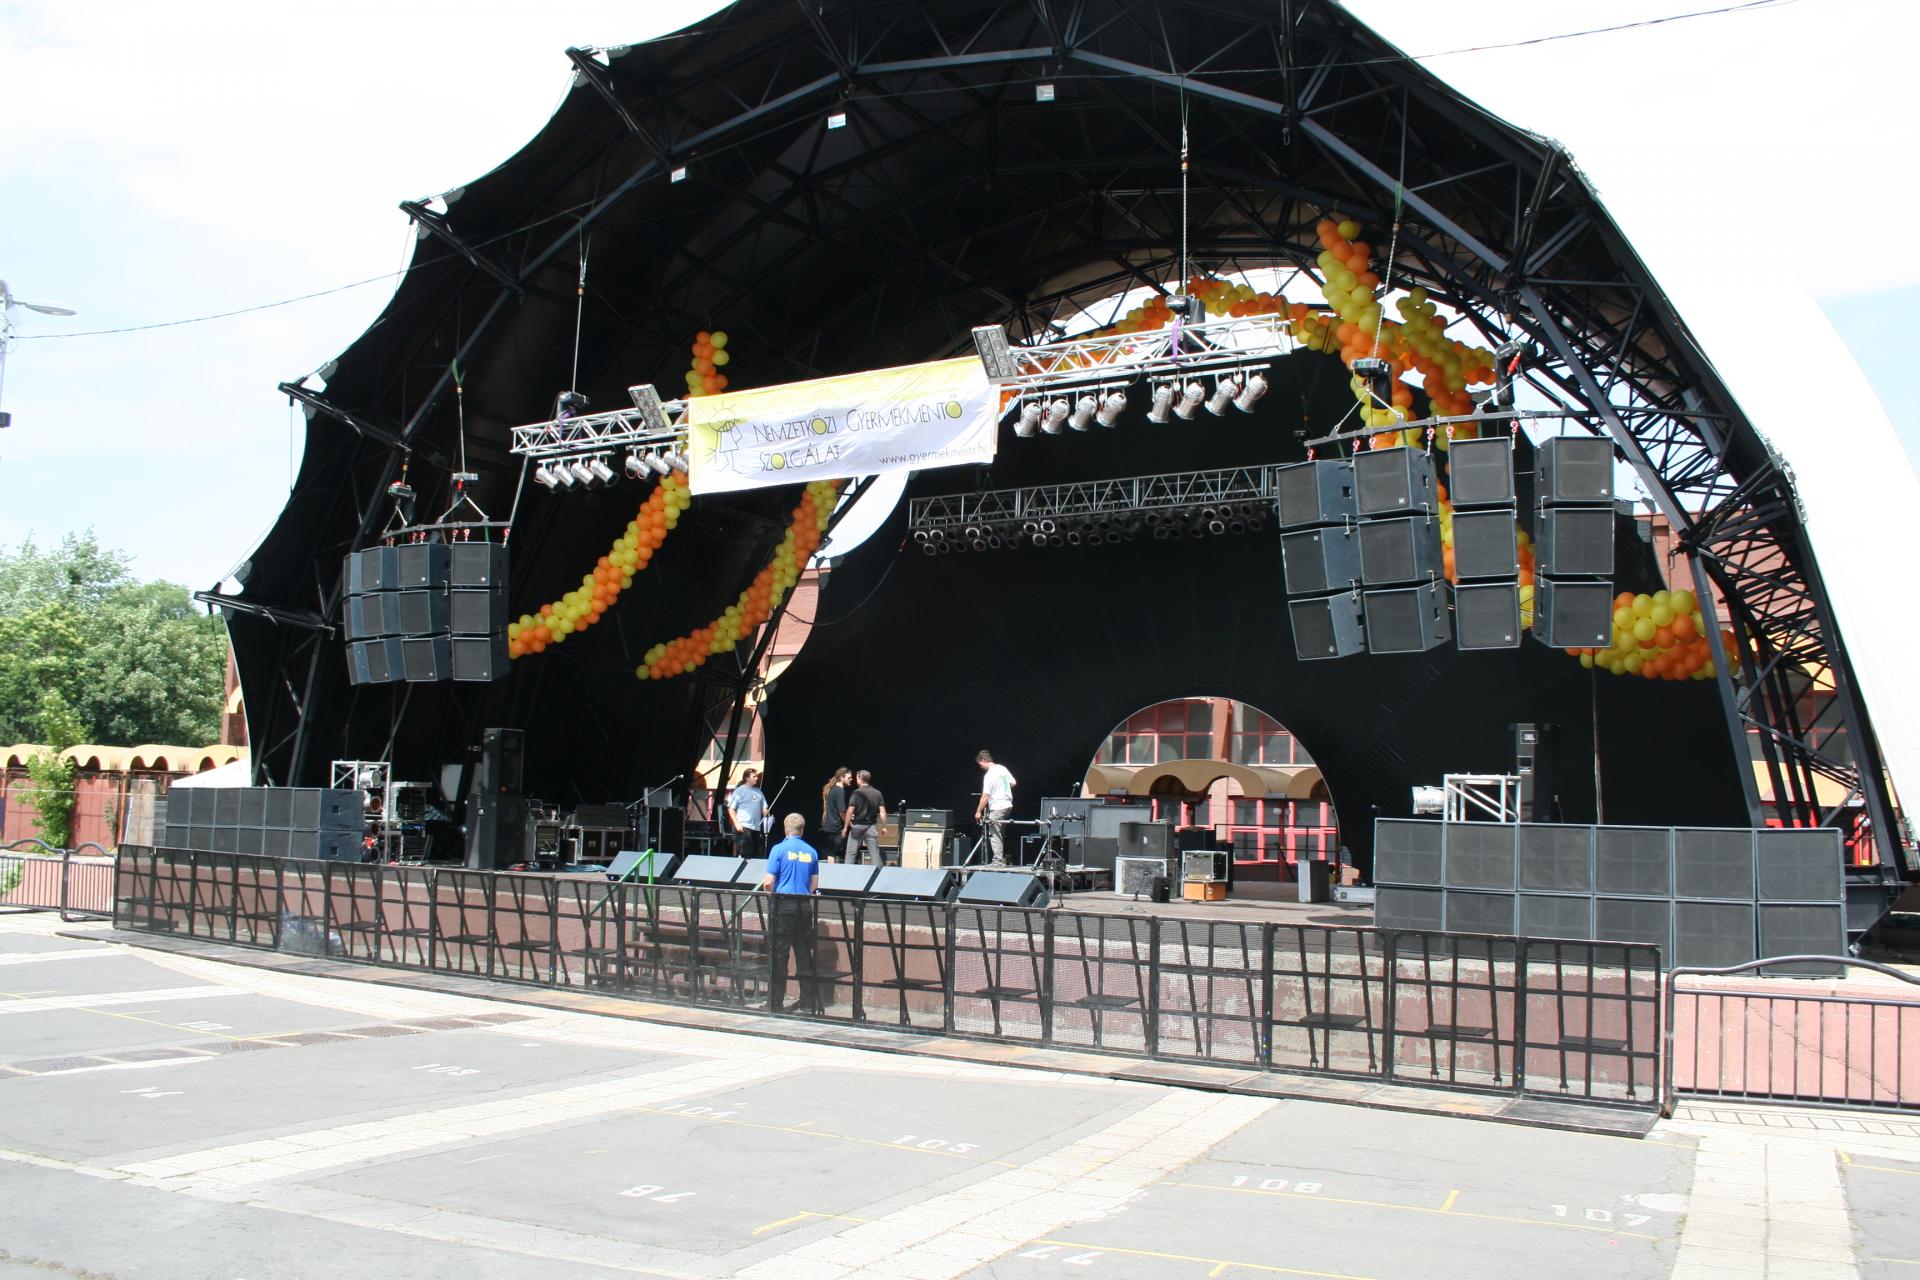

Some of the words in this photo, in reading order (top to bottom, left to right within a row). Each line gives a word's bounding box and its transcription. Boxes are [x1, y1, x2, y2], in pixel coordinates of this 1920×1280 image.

[753, 414, 837, 443] NEMZETKÖZI
[846, 394, 962, 432] GYERMEKMENTŐ
[760, 442, 840, 472] SZOLGÁLAT
[892, 1135, 981, 1153] 105
[1549, 1204, 1651, 1227] 107
